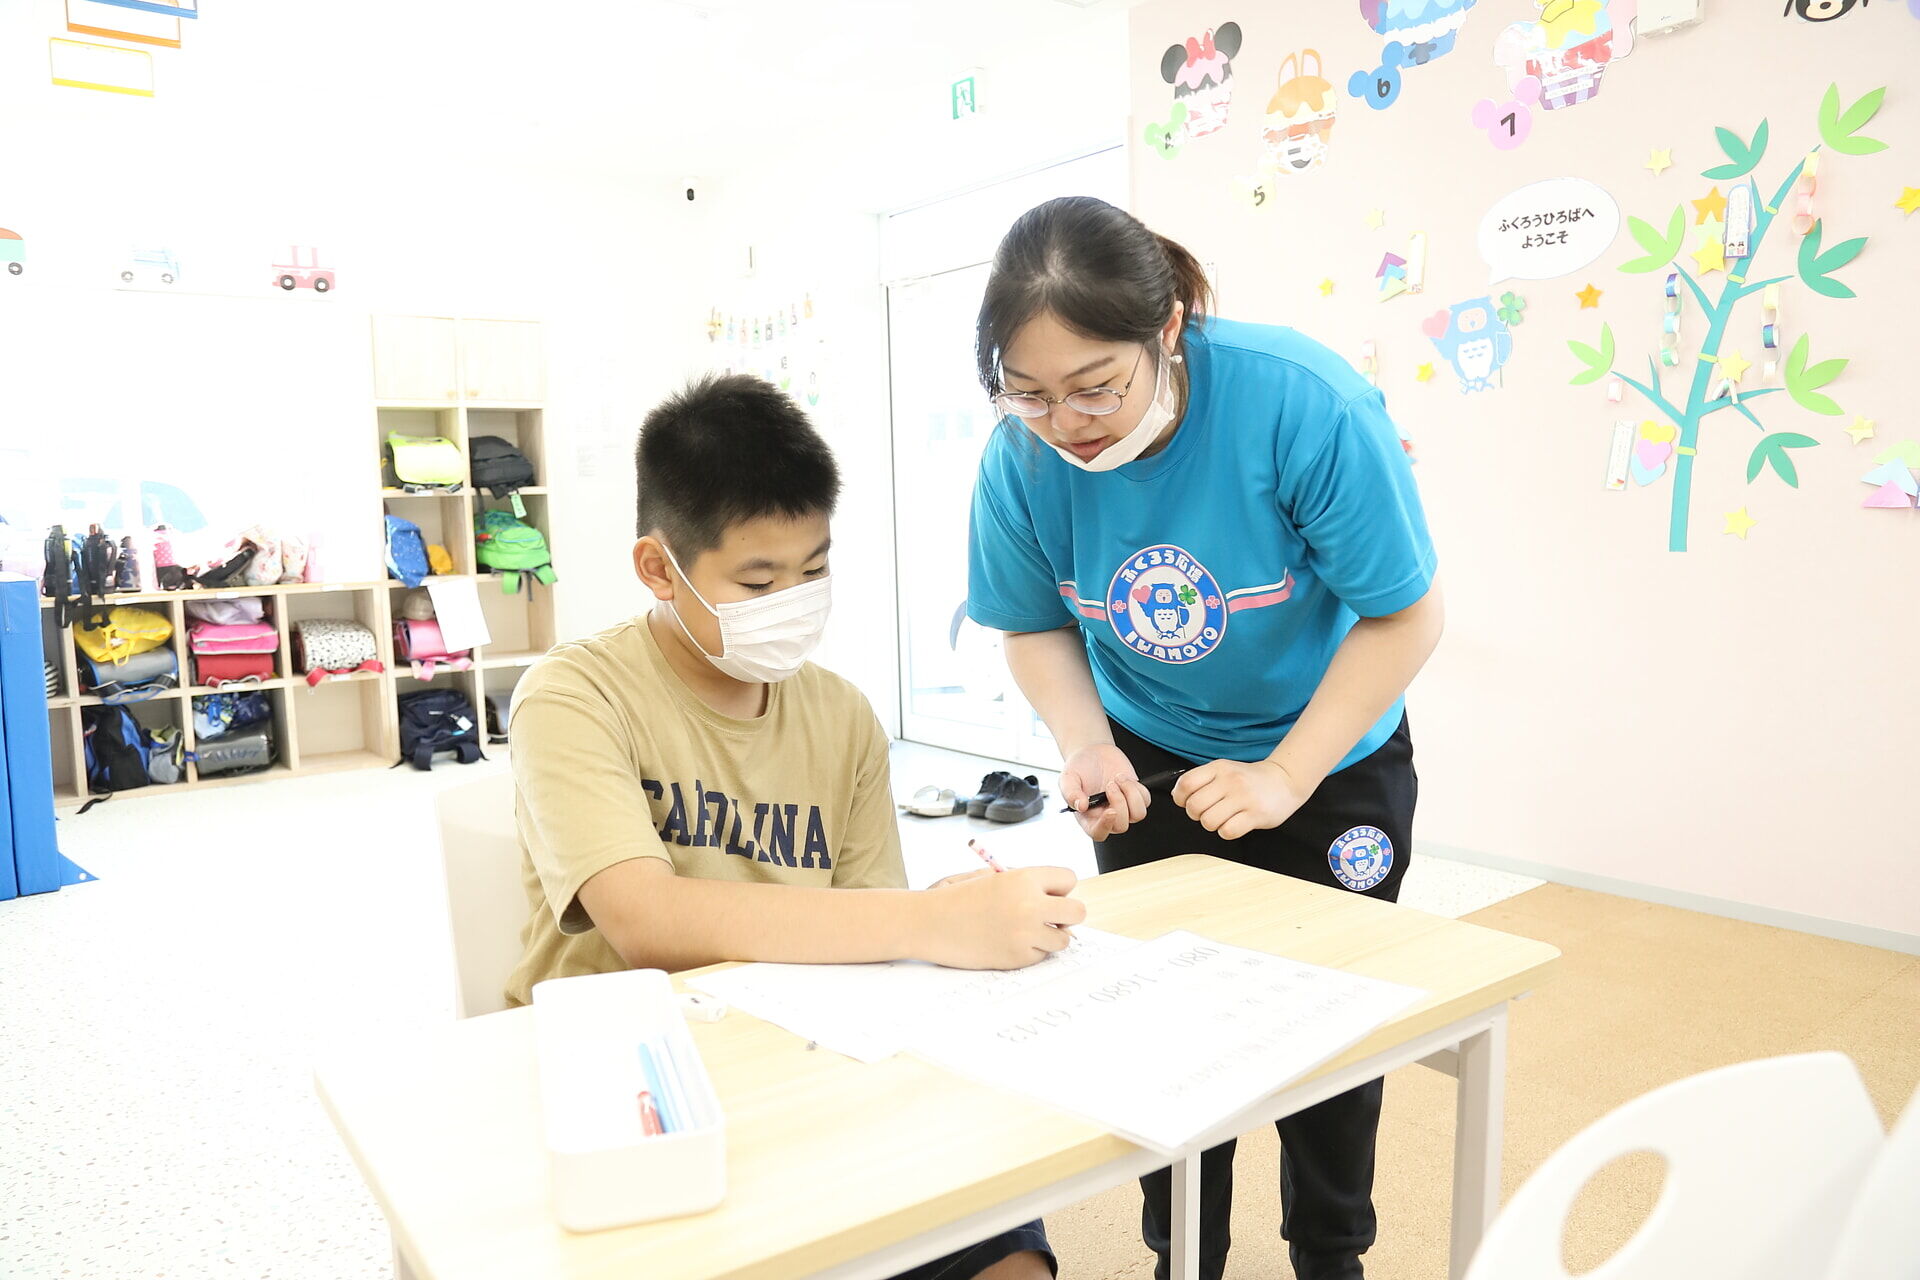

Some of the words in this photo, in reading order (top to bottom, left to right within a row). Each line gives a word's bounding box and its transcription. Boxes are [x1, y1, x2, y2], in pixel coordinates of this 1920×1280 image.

[1377, 78, 1390, 97] 6
[1500, 112, 1516, 137] 7
[1253, 186, 1266, 207] 5
[1498, 207, 1595, 232] ふくろうひろばへ
[1521, 230, 1569, 249] ようこそ
[1120, 549, 1204, 584] ふくろう広場
[1124, 626, 1219, 660] IWAMOTO
